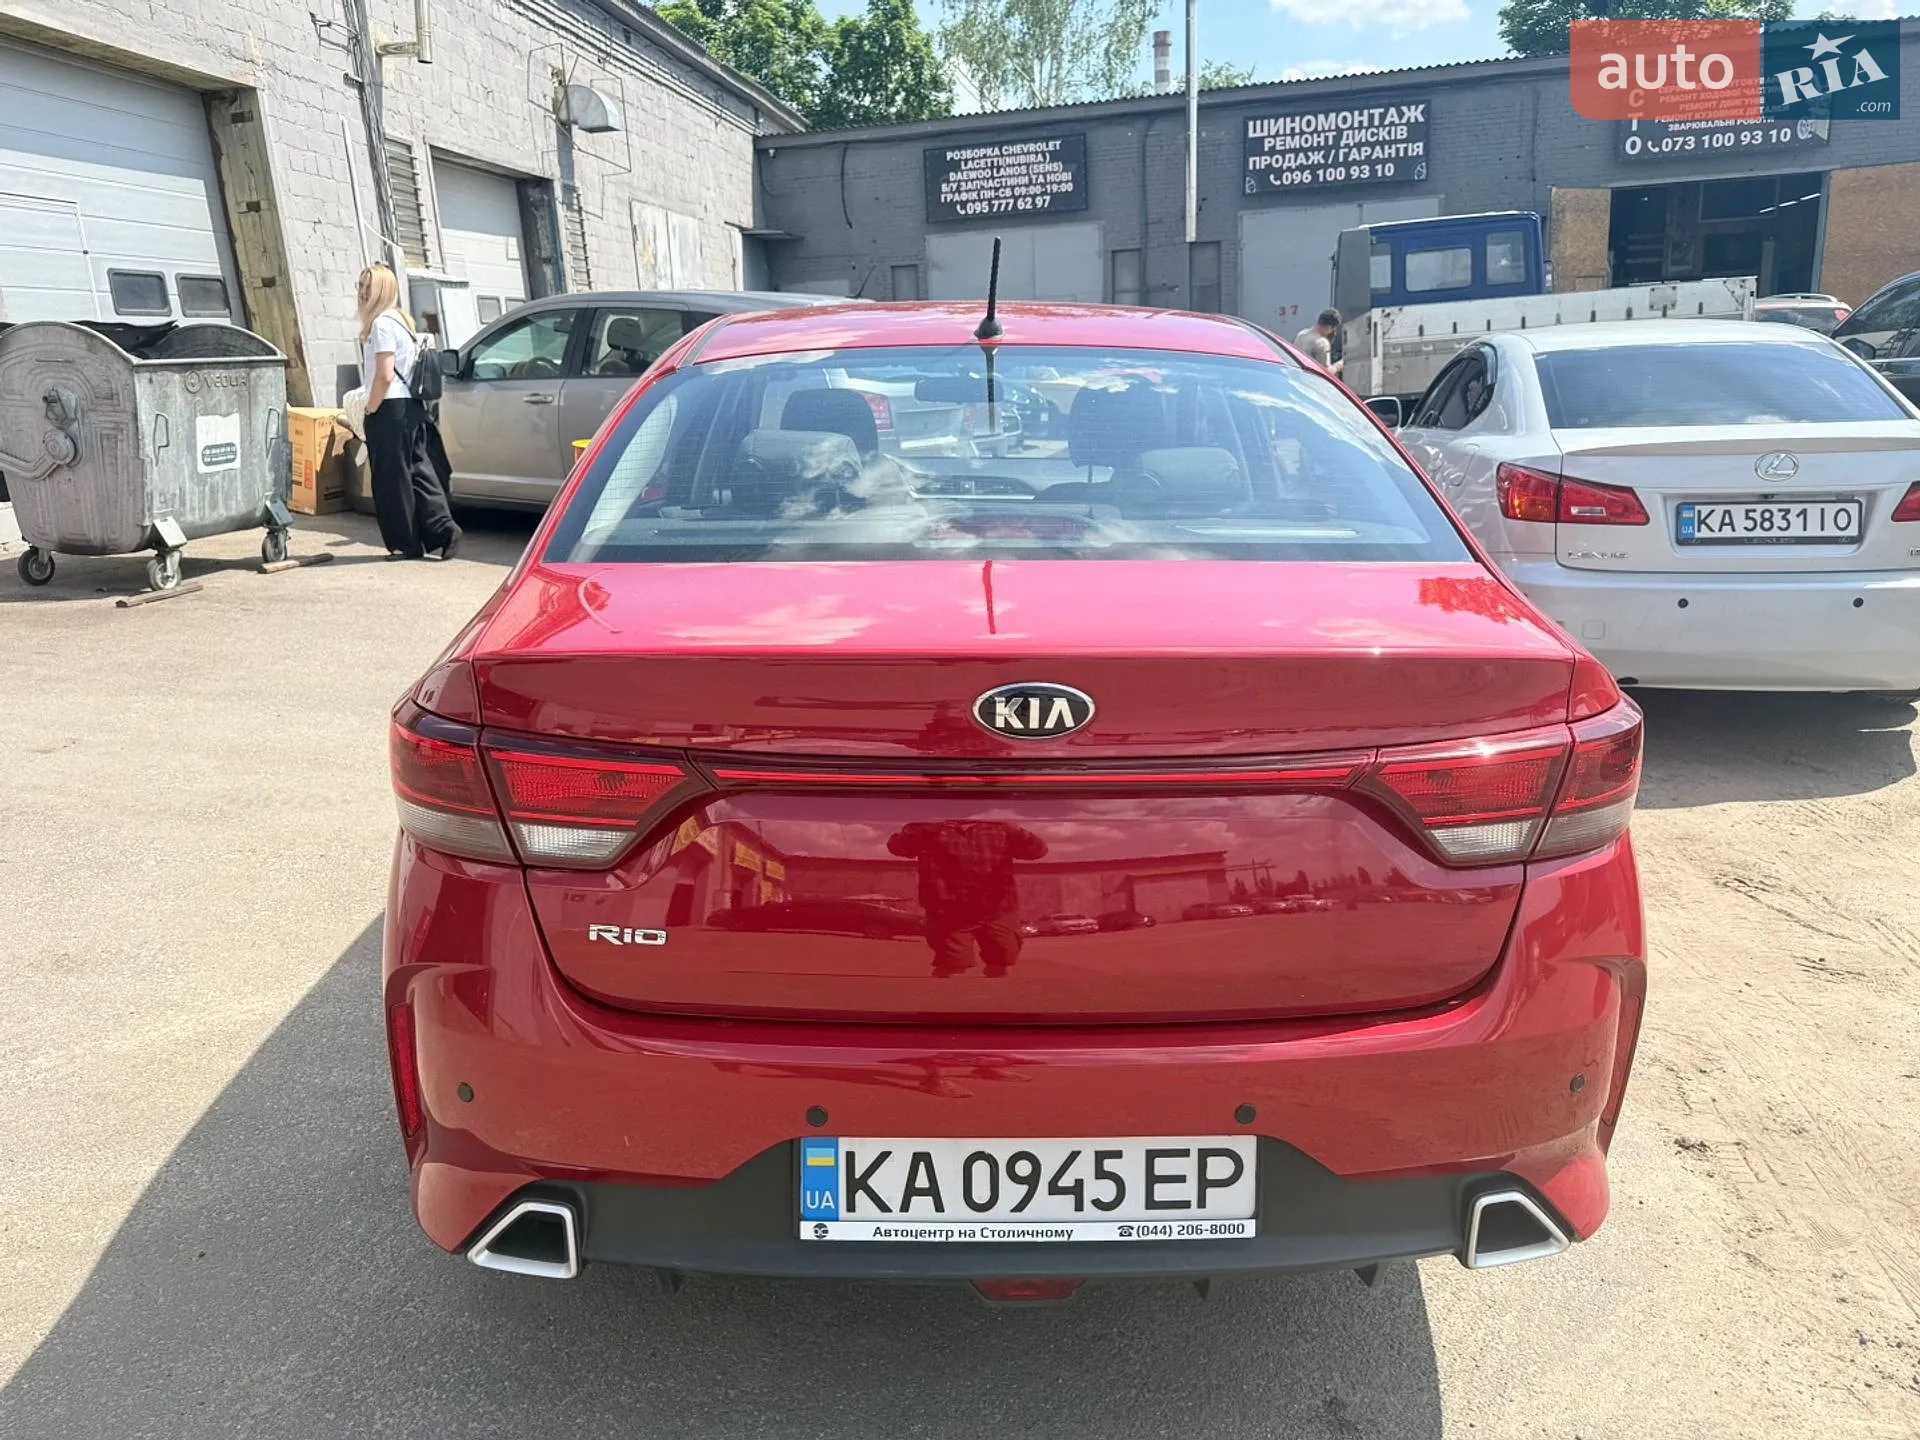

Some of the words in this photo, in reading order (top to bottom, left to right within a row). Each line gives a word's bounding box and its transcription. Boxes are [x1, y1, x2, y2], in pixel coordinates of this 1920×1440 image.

[1248, 104, 1426, 138] ШИНОМОНТАЖ
[1264, 131, 1337, 152] РЕМОНТ
[1340, 125, 1408, 147] ДИСКІВ
[1661, 136, 1696, 152] 073
[1701, 132, 1735, 149] 100
[1740, 130, 1763, 145] 93
[1767, 127, 1792, 143] 10
[946, 146, 1001, 161] РОЗБОРКА
[1002, 140, 1062, 155] CHEVROLET
[1248, 150, 1325, 170] ПРОДАЖ
[1327, 149, 1335, 165] /
[1338, 142, 1425, 163] ГАРАНТІЯ
[941, 182, 958, 193] Б/У
[959, 174, 1029, 191] ЗАПЧАСТИНИ
[1031, 174, 1045, 184] ТА
[1046, 171, 1072, 183] НОВІ
[949, 169, 992, 182] DAEWOO
[993, 165, 1028, 178] LANOS
[1029, 160, 1063, 176] (SENS)
[1282, 170, 1312, 185] 096
[1316, 167, 1346, 182] 100
[1350, 165, 1370, 179] 93
[1375, 163, 1395, 178] 10
[941, 190, 979, 203] ГРАФІК
[980, 187, 1012, 199] ПН-СБ
[1014, 182, 1074, 197] 09:00-19:00
[966, 201, 989, 215] 095
[991, 198, 1014, 213] 777
[1017, 196, 1033, 210] 62
[1035, 195, 1051, 208] 97
[1681, 525, 1694, 535] UA
[1696, 508, 1737, 534] KA
[1743, 507, 1808, 533] 5831
[994, 696, 1076, 729] KIA
[806, 1193, 835, 1210] UA
[845, 1150, 946, 1214] KA
[962, 1148, 1128, 1214] 0945
[1144, 1147, 1245, 1211] EP
[872, 1226, 954, 1241] Автоцентр
[957, 1228, 977, 1239] на
[980, 1226, 1074, 1242] Столичному
[1136, 1223, 1173, 1239] (044)
[1177, 1222, 1246, 1237] 206-8000
